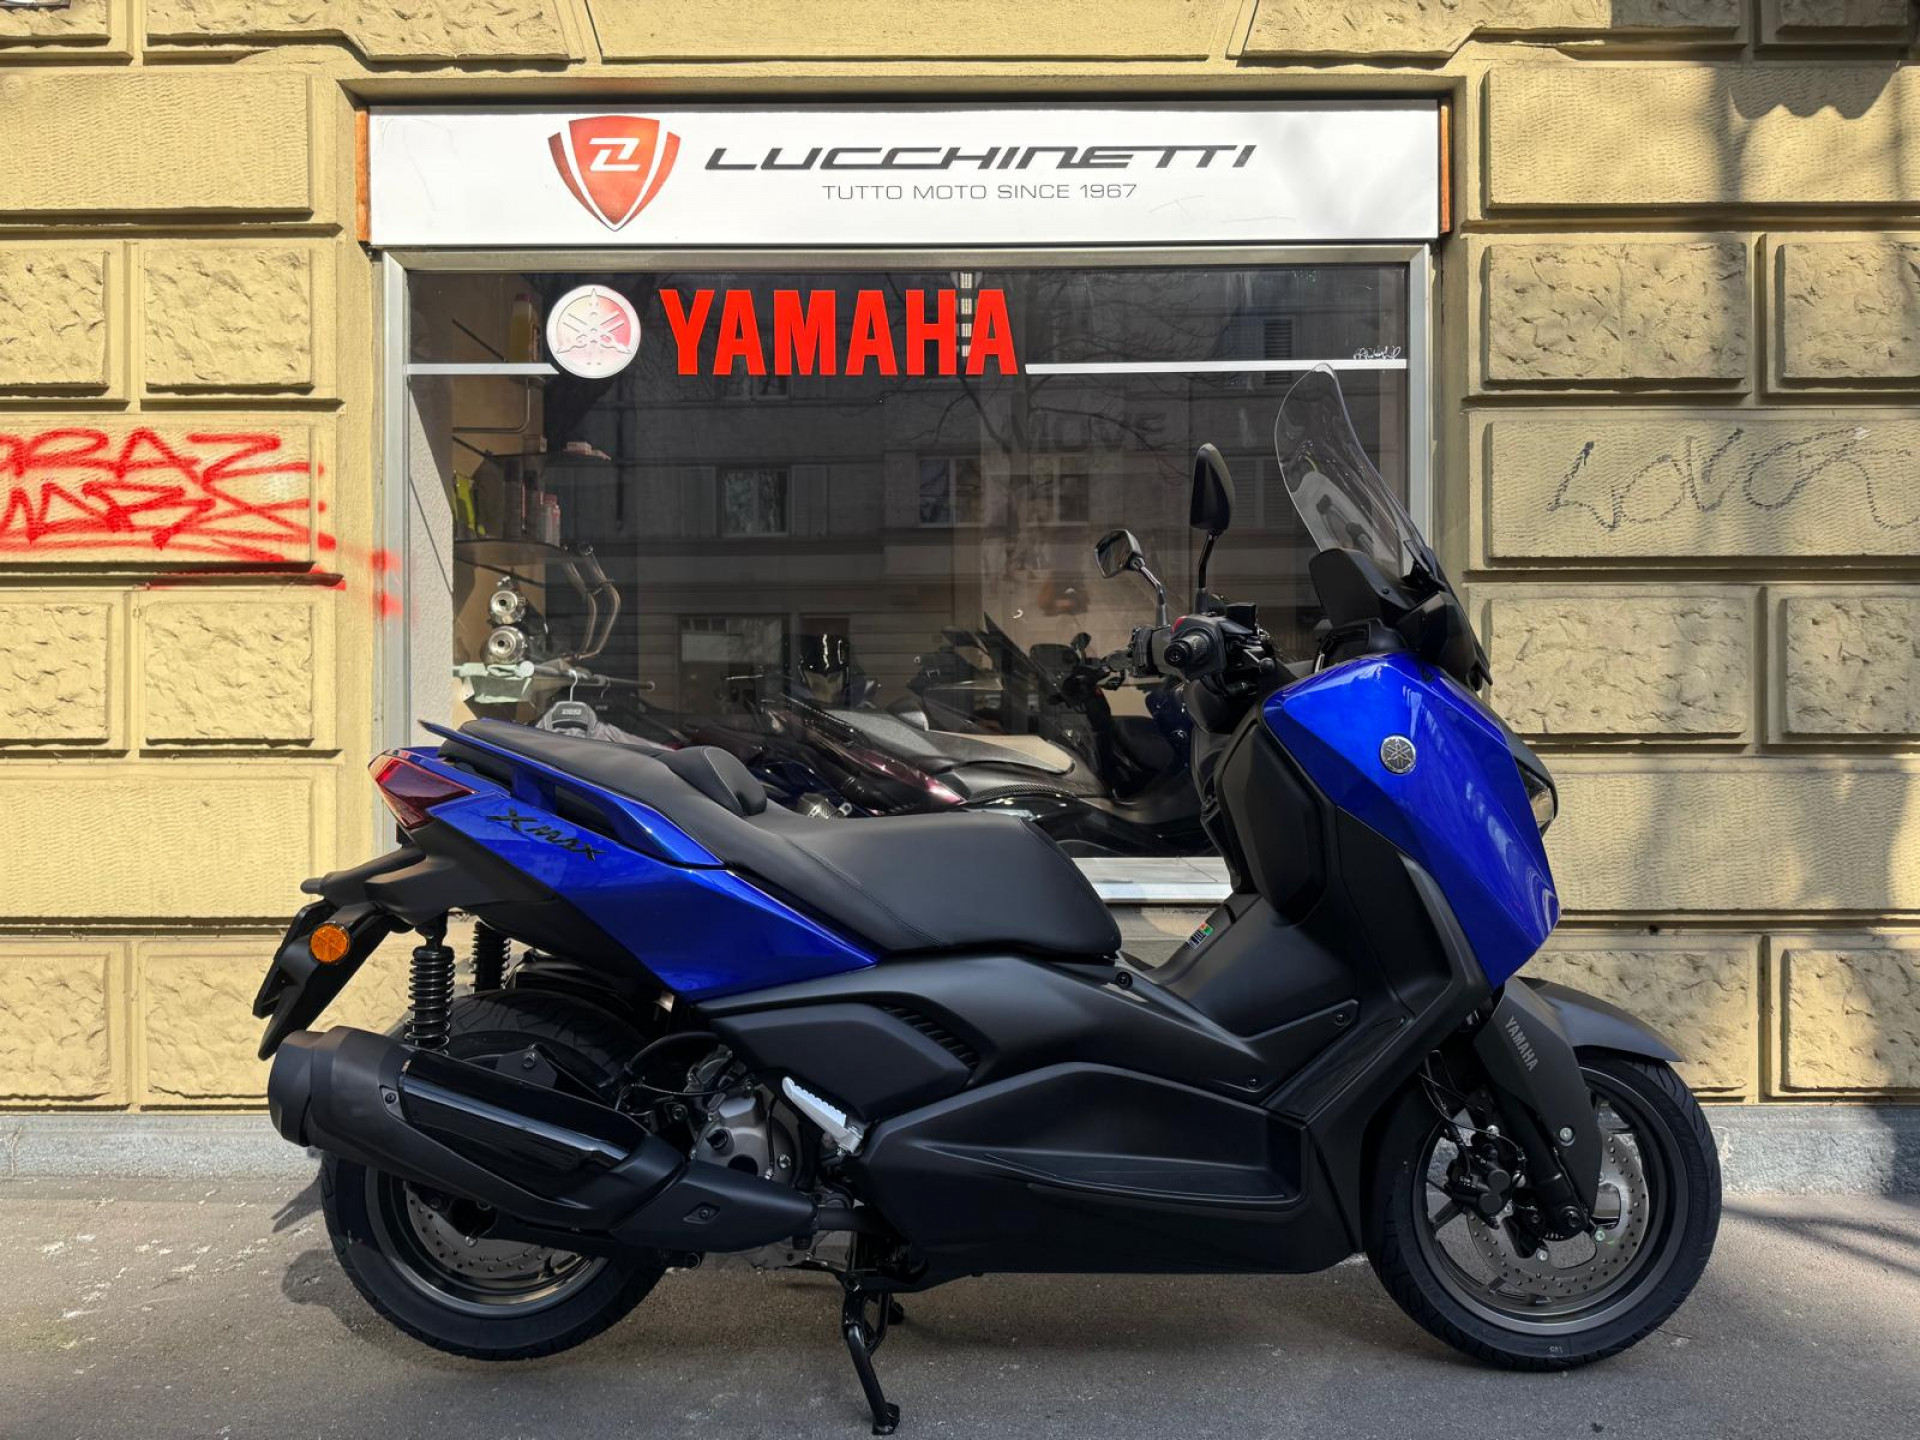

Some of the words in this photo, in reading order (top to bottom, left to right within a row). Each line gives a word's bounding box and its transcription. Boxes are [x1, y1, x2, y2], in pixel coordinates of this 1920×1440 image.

[704, 144, 1257, 169] LUCCHINETTI
[821, 184, 903, 201] TUTTO
[913, 184, 987, 200] MOTO
[996, 183, 1070, 199] SINCE
[1079, 183, 1138, 199] 1967
[659, 288, 1018, 376] YAMAHA
[1505, 1015, 1539, 1072] YAMAHA
